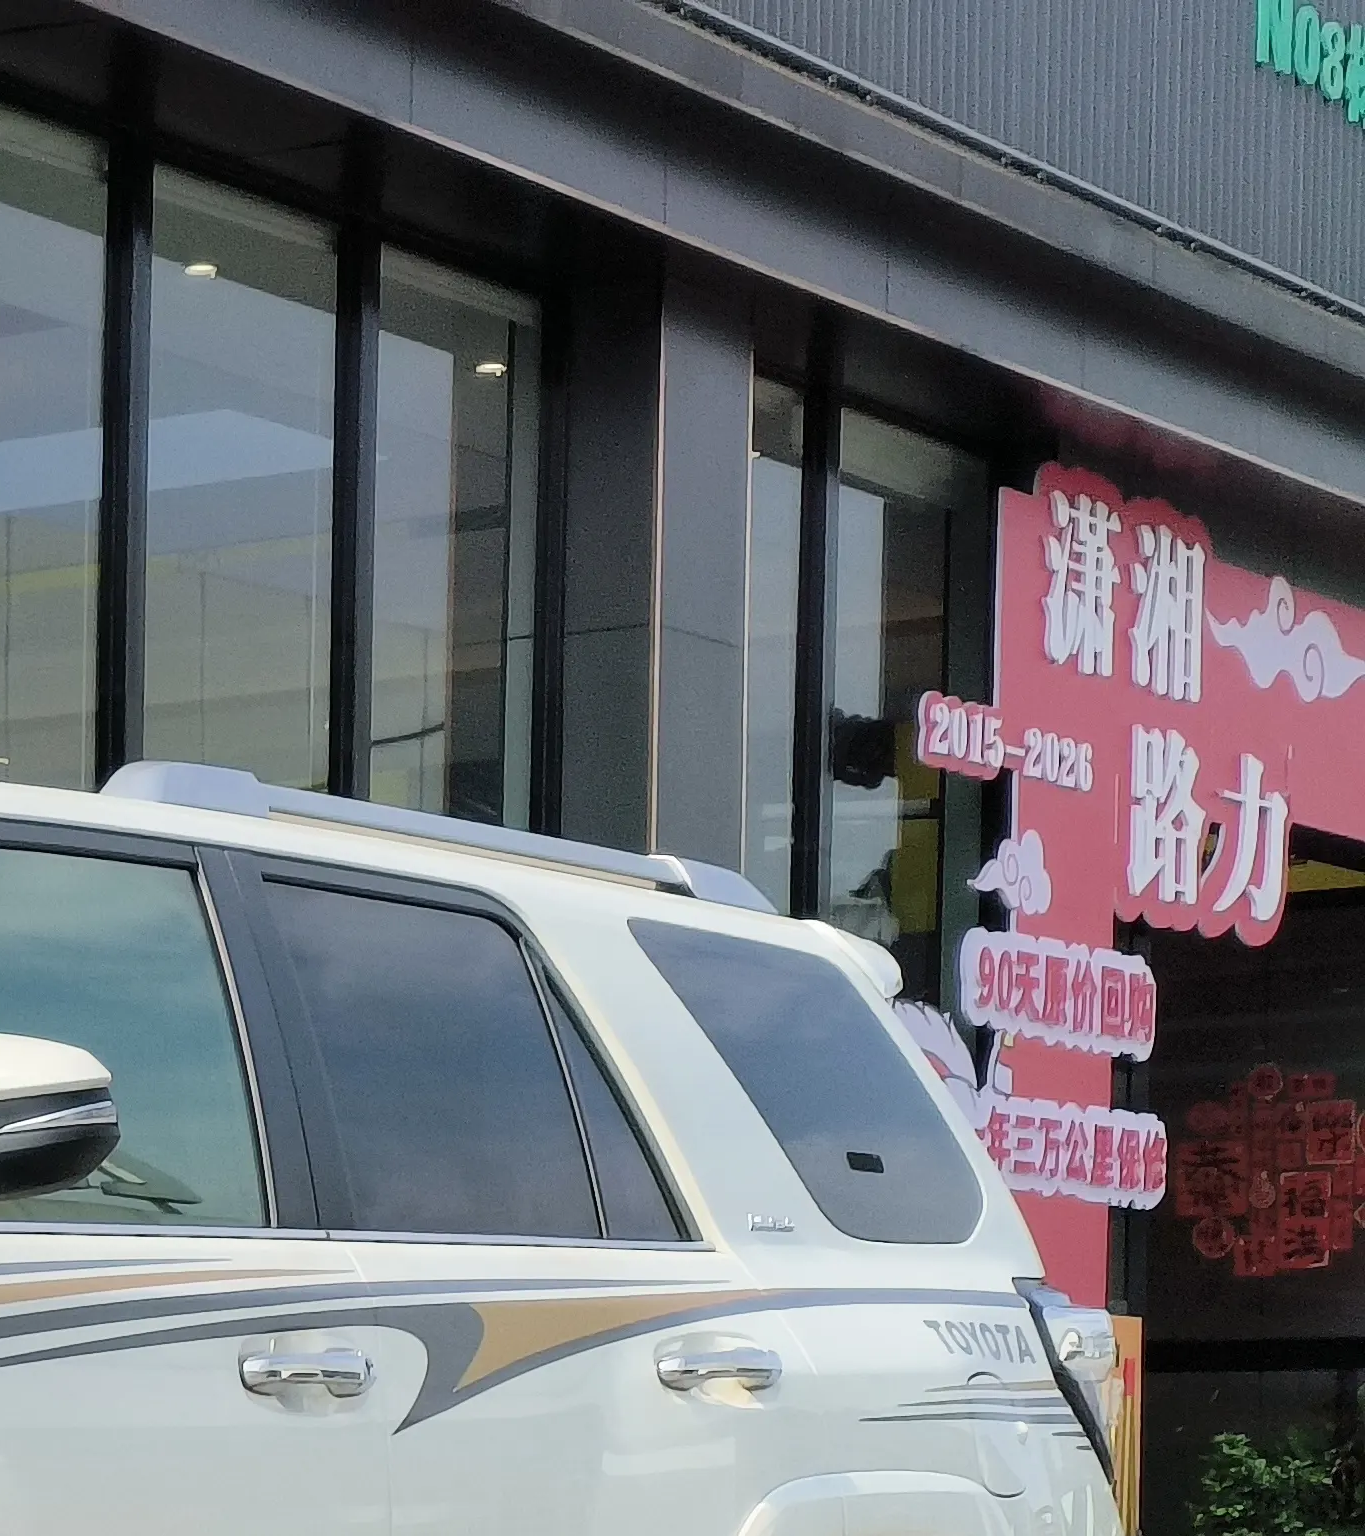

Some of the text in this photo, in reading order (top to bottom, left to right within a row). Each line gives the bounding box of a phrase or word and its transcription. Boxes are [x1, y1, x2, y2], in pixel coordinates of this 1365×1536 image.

[1041, 490, 1205, 702] 潇湘
[929, 703, 1094, 792] 2015-2026
[1129, 724, 1289, 920] 路力
[976, 947, 1154, 1043] 90天原价回购
[975, 1105, 1167, 1192] 年三万公里保修
[923, 1319, 1037, 1364] TOYOTA
